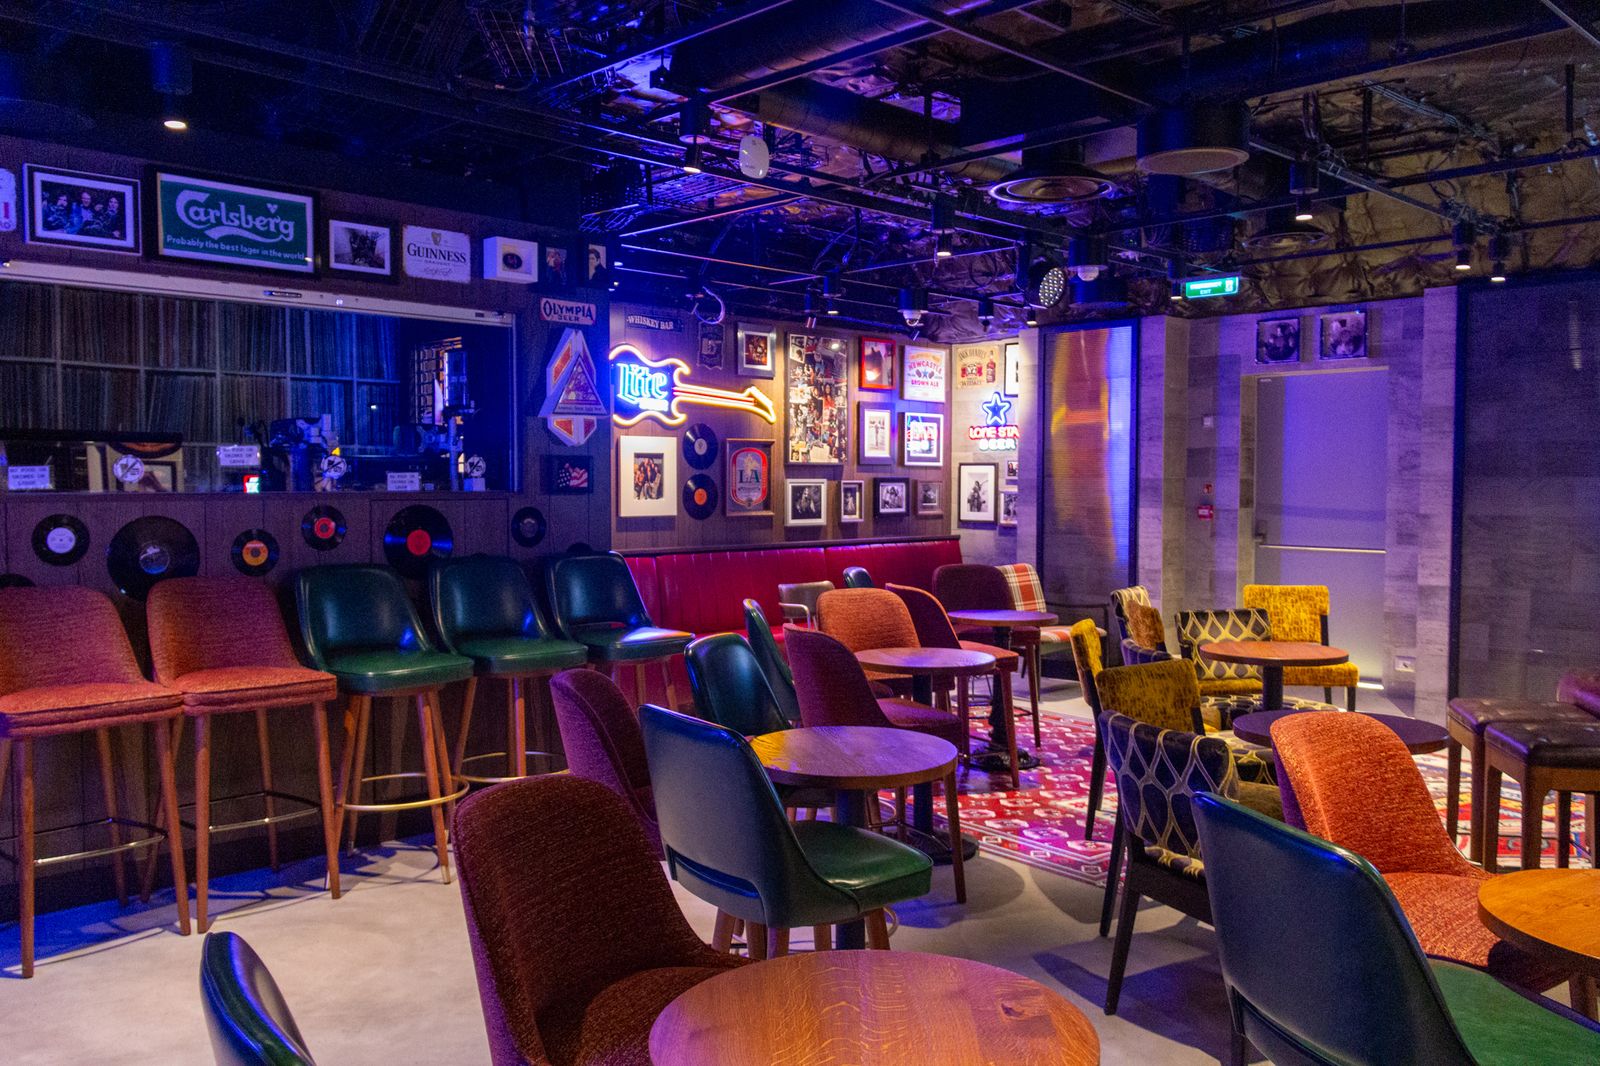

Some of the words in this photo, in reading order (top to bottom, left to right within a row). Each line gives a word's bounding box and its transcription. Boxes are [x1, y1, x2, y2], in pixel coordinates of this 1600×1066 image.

[176, 190, 295, 241] Carlsberg
[166, 235, 204, 249] Probably
[205, 239, 218, 249] the
[220, 241, 239, 252] best
[240, 244, 260, 255] lager
[261, 247, 269, 255] in
[269, 247, 281, 257] the
[407, 243, 467, 263] GUINNESS
[543, 300, 594, 321] OLYMPIA
[628, 315, 660, 329] WHISKEY
[660, 321, 674, 330] BAR
[616, 362, 668, 405] Lite
[969, 426, 997, 440] LONE
[998, 425, 1019, 439] STA
[739, 469, 760, 483] LA
